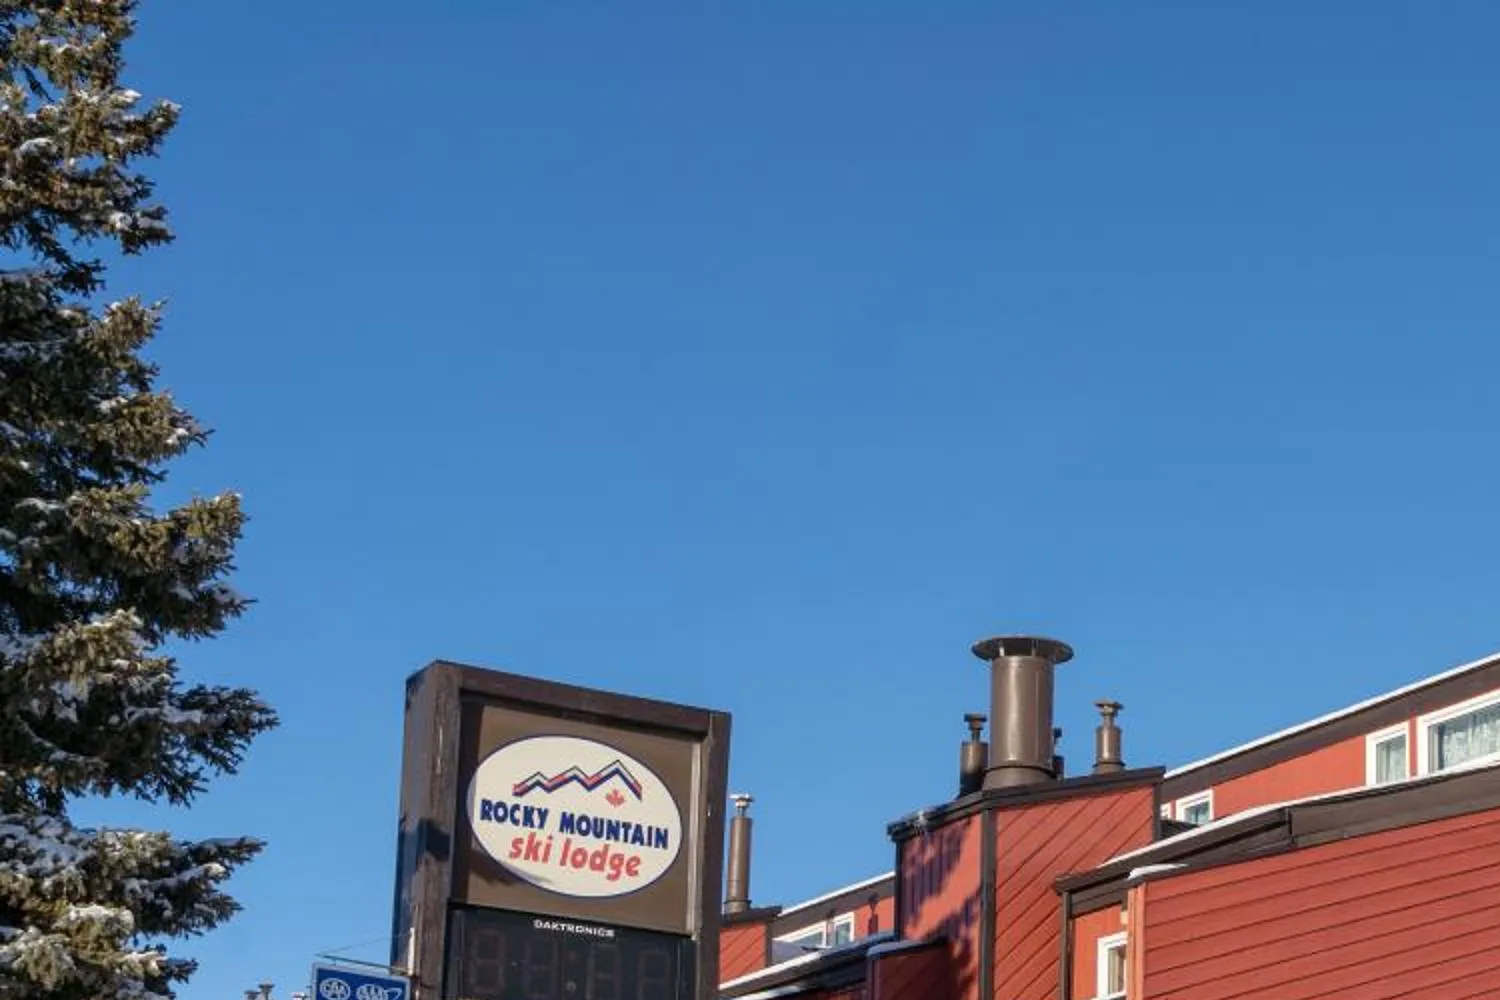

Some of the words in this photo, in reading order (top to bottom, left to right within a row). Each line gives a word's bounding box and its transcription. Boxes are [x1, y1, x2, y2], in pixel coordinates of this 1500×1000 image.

[480, 798, 549, 829] ROCKY
[558, 811, 669, 850] MOUNTAIN
[509, 832, 554, 863] ski
[559, 838, 642, 881] lodge
[533, 919, 615, 937] DAKTRONICS
[320, 978, 350, 1000] CAA
